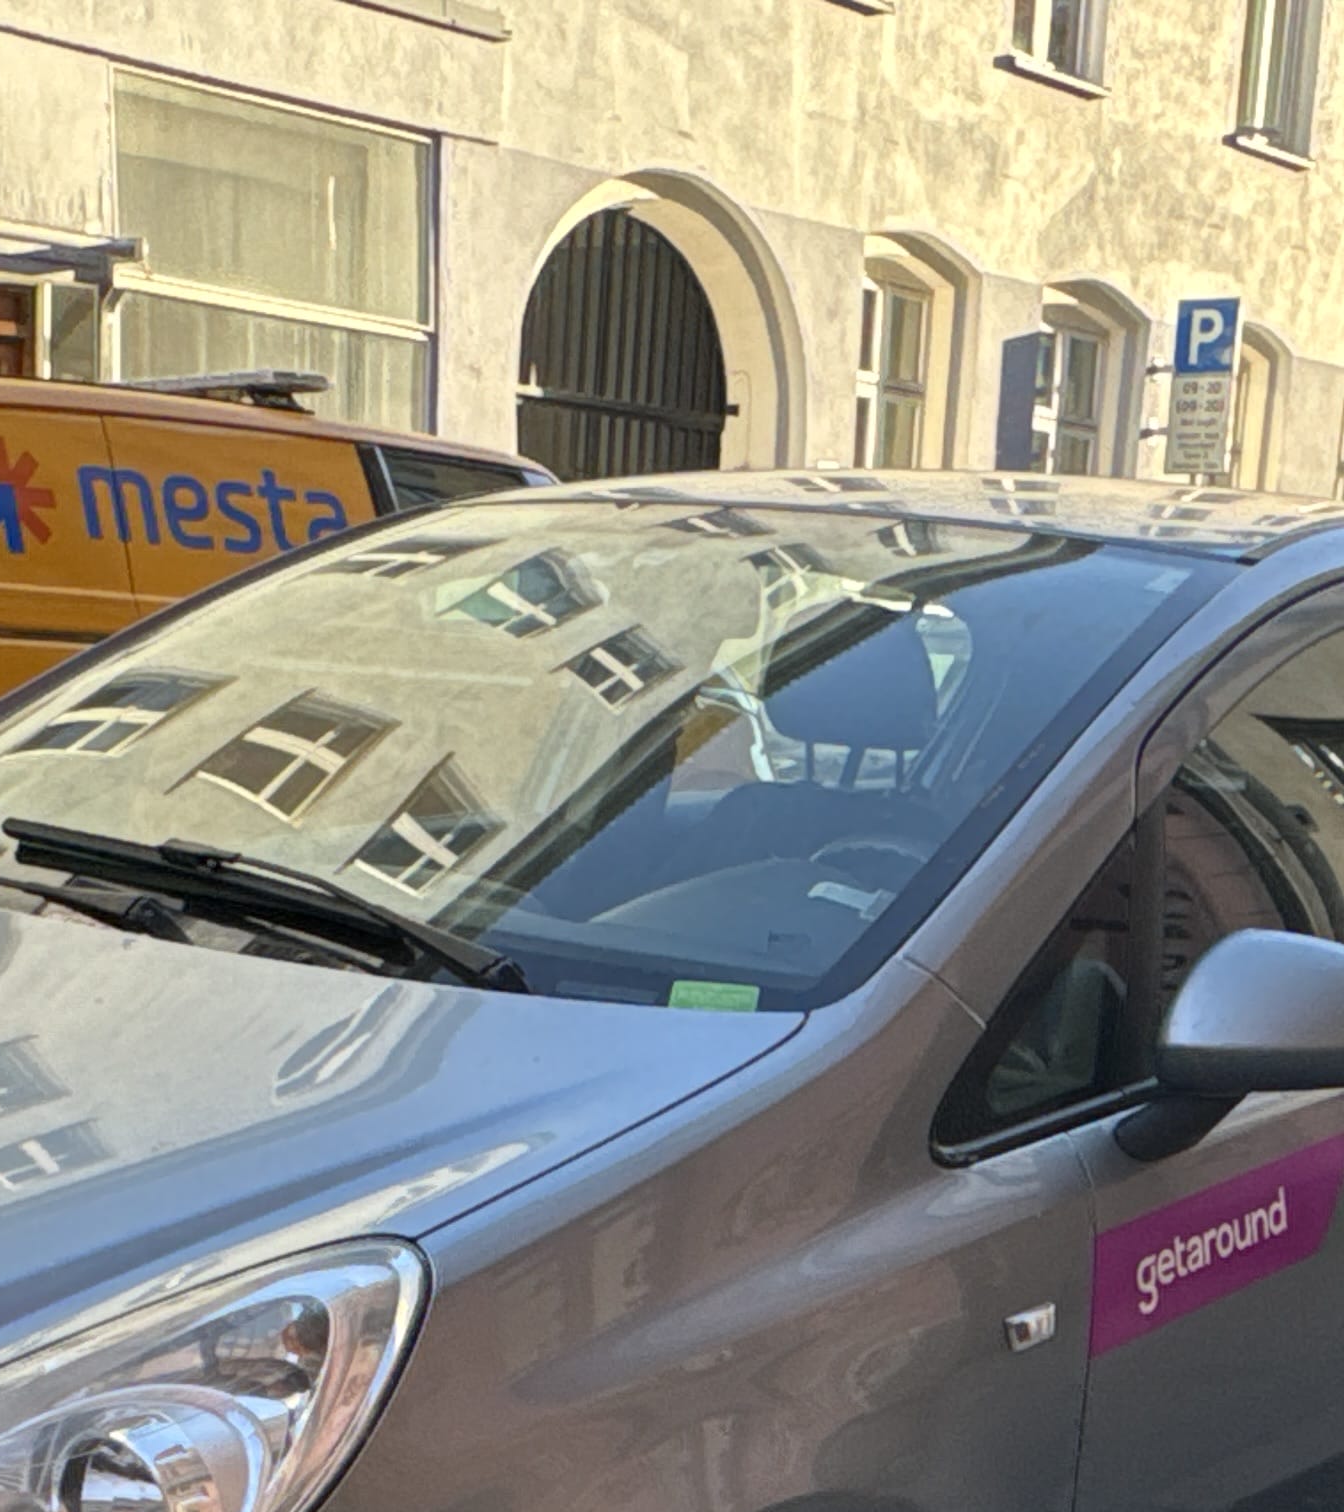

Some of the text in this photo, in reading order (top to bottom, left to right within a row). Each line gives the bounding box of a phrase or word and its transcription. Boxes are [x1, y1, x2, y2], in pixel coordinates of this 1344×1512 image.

[1188, 308, 1224, 365] P
[77, 464, 348, 553] mesta
[1136, 1185, 1289, 1316] getaround
